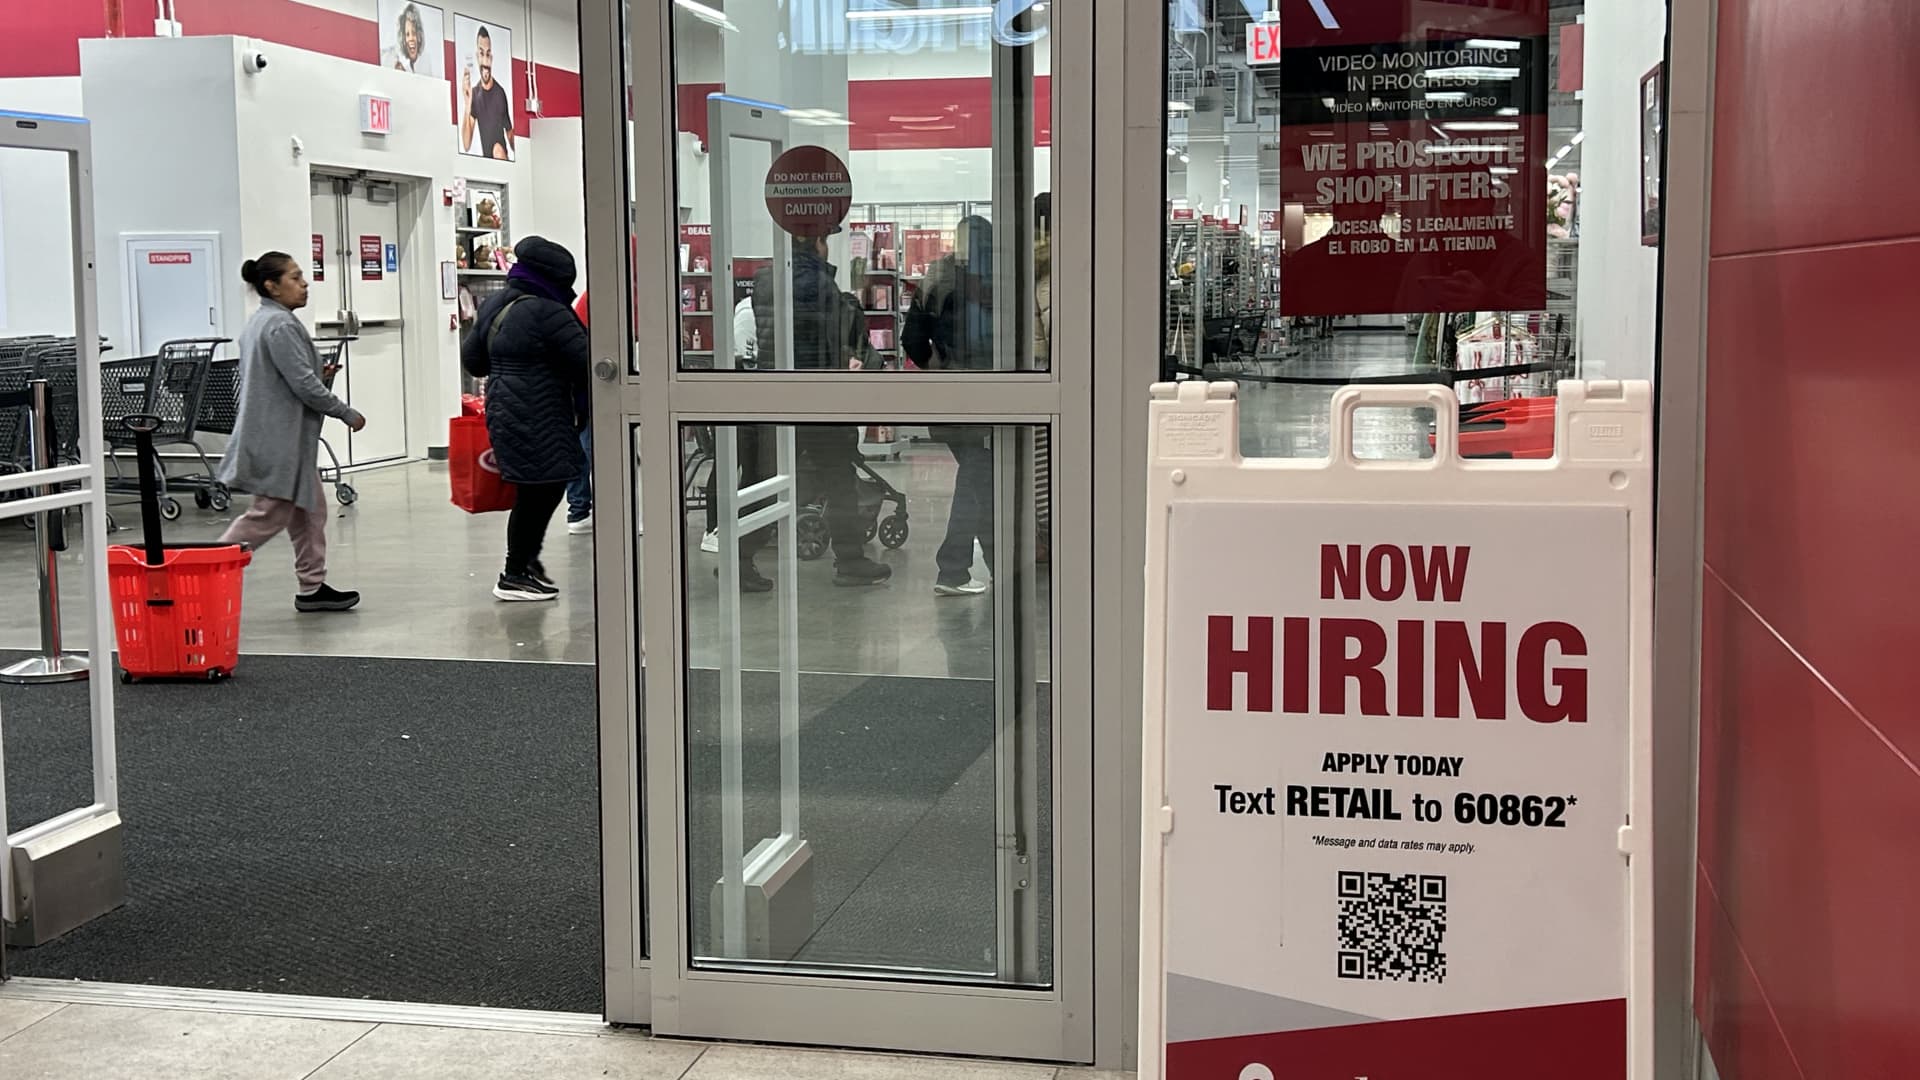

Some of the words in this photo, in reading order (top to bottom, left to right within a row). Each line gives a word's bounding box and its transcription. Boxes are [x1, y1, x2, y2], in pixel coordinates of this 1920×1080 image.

[1319, 54, 1376, 72] VIDEO
[1383, 48, 1508, 69] MONITORING
[1348, 75, 1366, 92] IN
[1372, 72, 1479, 91] PROGRESS
[370, 98, 390, 129] EXIT
[1330, 102, 1363, 113] VIDEO
[1366, 99, 1434, 112] MONITOREO
[1438, 98, 1453, 108] EN
[1456, 96, 1497, 108] CURSO
[1301, 143, 1347, 172] WE
[1357, 136, 1525, 169] PROSECUTE
[774, 173, 788, 182] DO
[790, 172, 809, 182] NOT
[811, 172, 842, 181] ENTER
[773, 186, 819, 195] Automatic
[822, 185, 844, 194] Door
[1316, 171, 1511, 205] SHOPLIFTERS
[785, 203, 833, 216] CAUTION
[687, 226, 711, 236] DEALS
[1416, 215, 1514, 232] LEGALMENTE
[1329, 241, 1346, 255] EL
[1350, 240, 1390, 254] ROBO
[1395, 239, 1415, 253] EN
[1420, 238, 1439, 252] LA
[1443, 236, 1497, 251] TIENDA
[1320, 544, 1471, 602] NOW
[1207, 615, 1588, 723] HIRING
[1322, 752, 1390, 774] APPLY
[1394, 755, 1464, 777] TODAY
[1214, 785, 1276, 815] Text
[1287, 785, 1402, 820] RETAIL
[1412, 794, 1442, 822] to
[1358, 838, 1377, 848] and
[1378, 838, 1398, 849] data
[1400, 840, 1425, 850] rates
[1426, 842, 1447, 854] may
[1448, 842, 1476, 854] apply.
